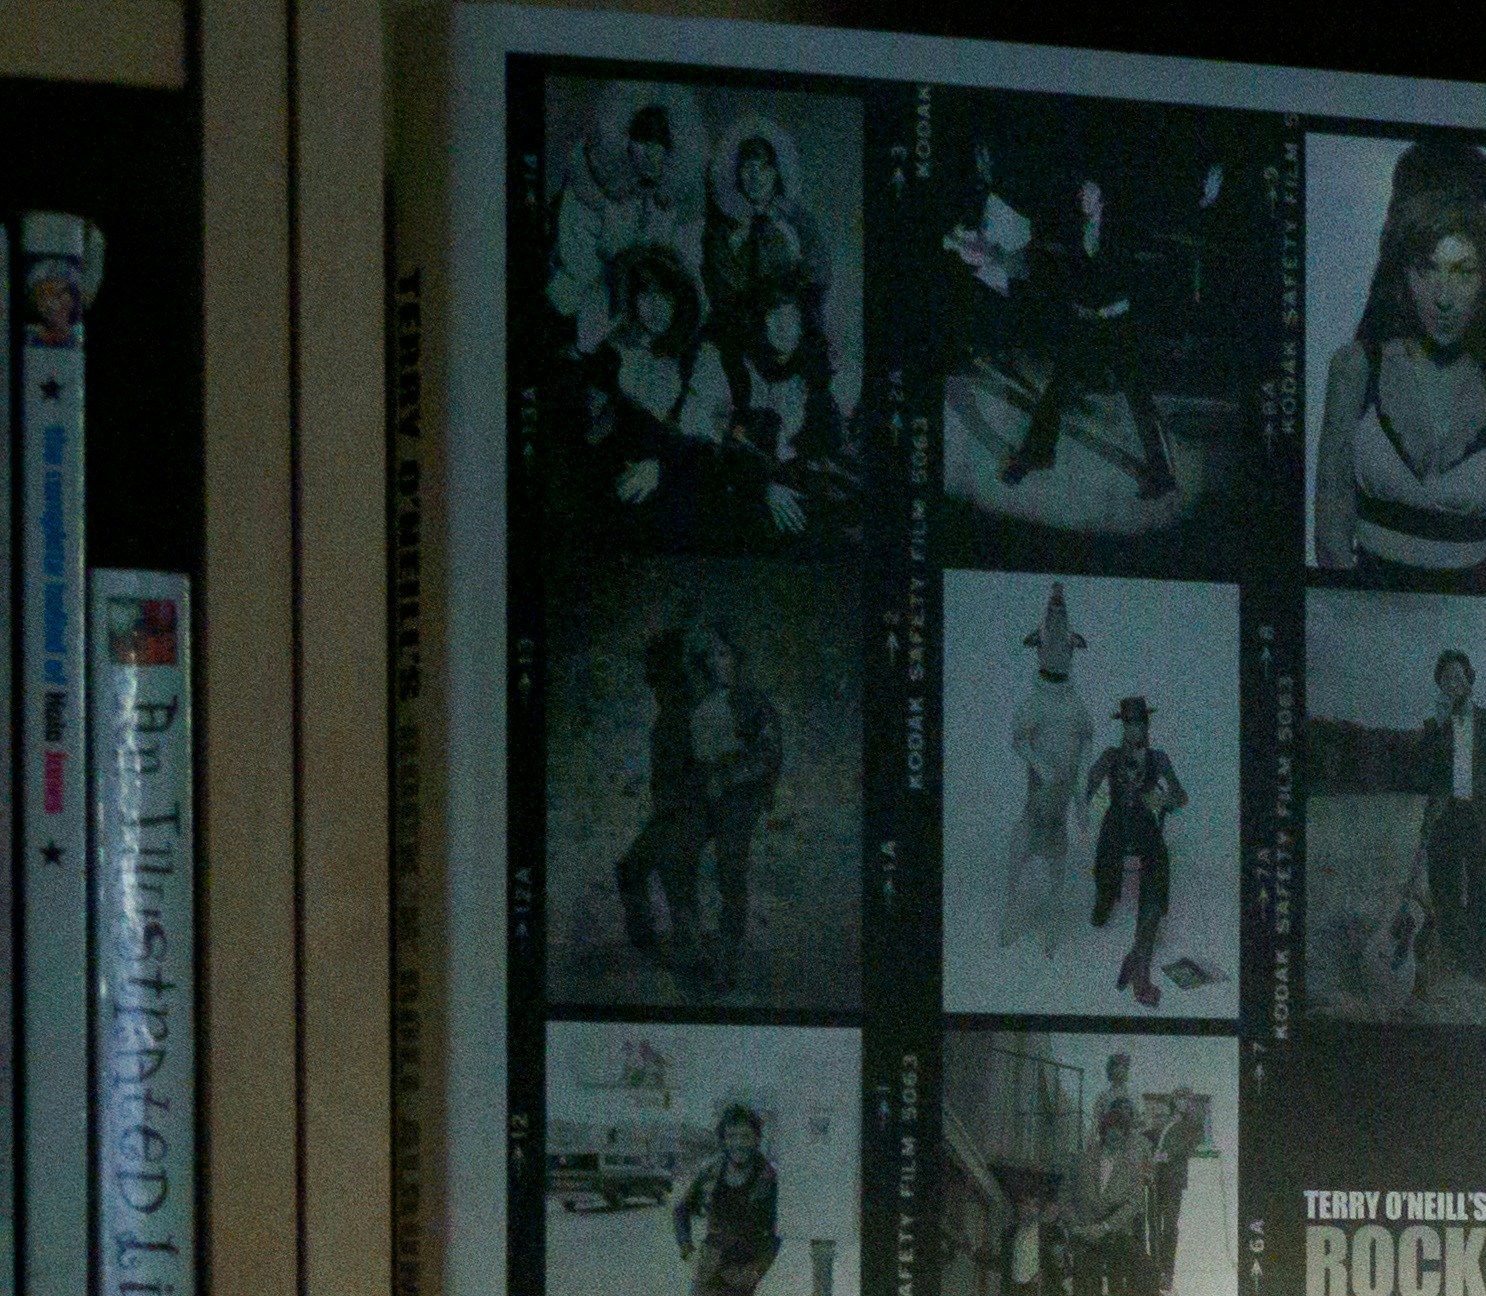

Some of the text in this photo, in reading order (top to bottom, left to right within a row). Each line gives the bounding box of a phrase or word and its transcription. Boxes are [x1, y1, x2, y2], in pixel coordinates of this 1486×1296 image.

[900, 1053, 920, 1122] 5063
[898, 1136, 916, 1200] FILM
[1302, 1189, 1380, 1222] TERRY
